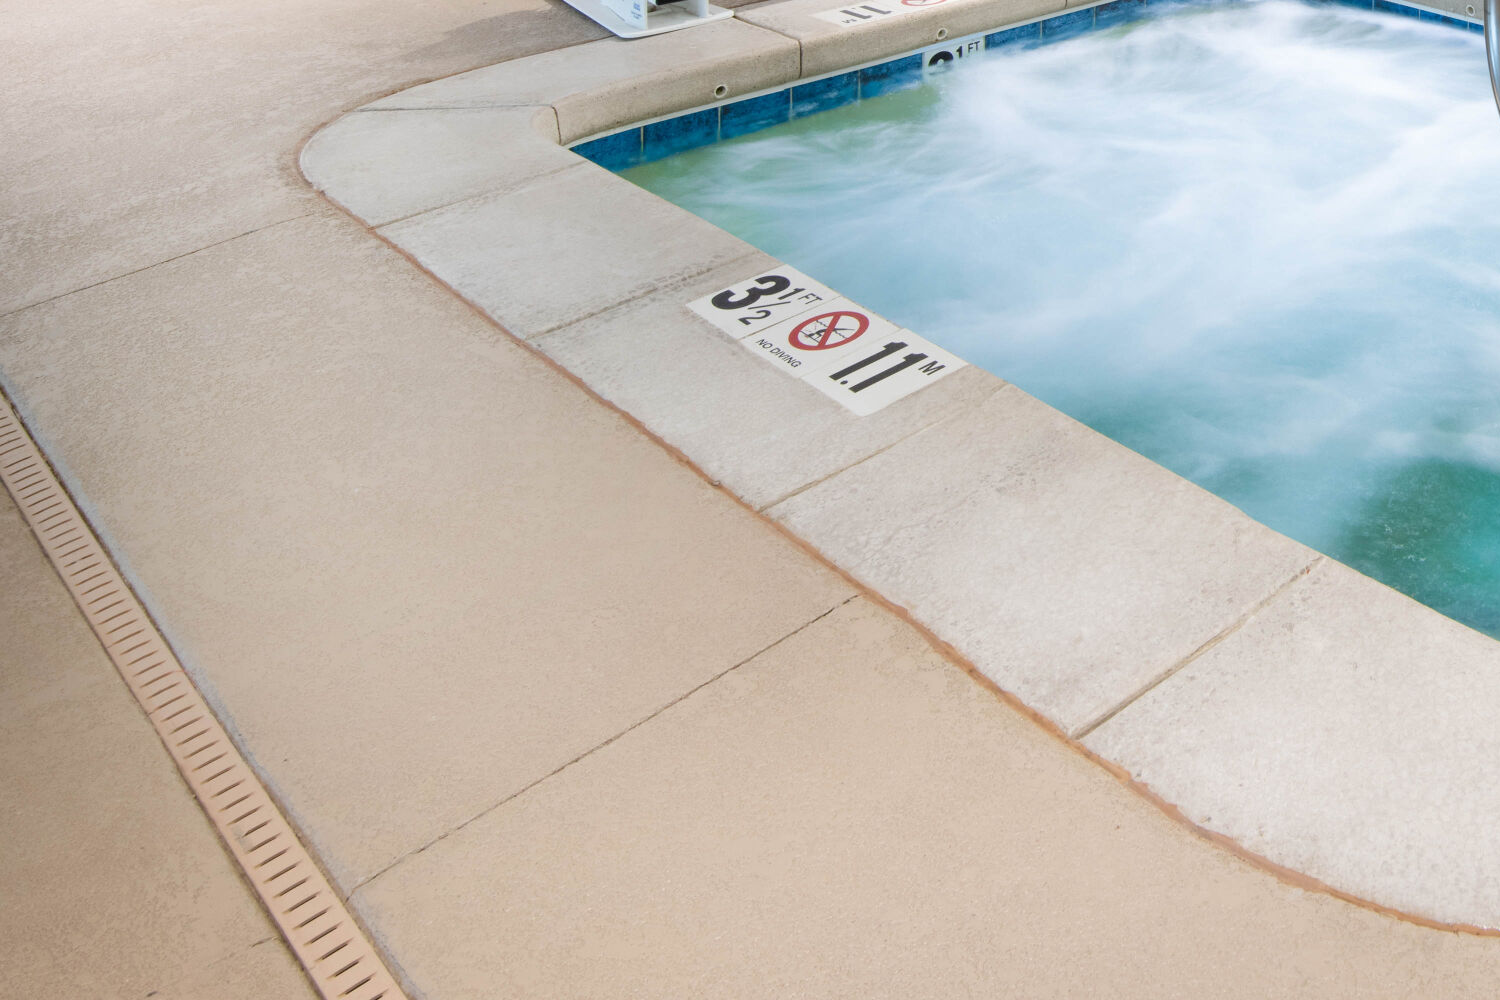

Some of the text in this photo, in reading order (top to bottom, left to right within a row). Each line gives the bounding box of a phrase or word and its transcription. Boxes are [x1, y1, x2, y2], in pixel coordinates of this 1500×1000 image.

[968, 40, 981, 53] FT
[800, 292, 823, 305] FT
[755, 338, 802, 369] NO DIVING
[829, 341, 946, 394] 1.1 M
